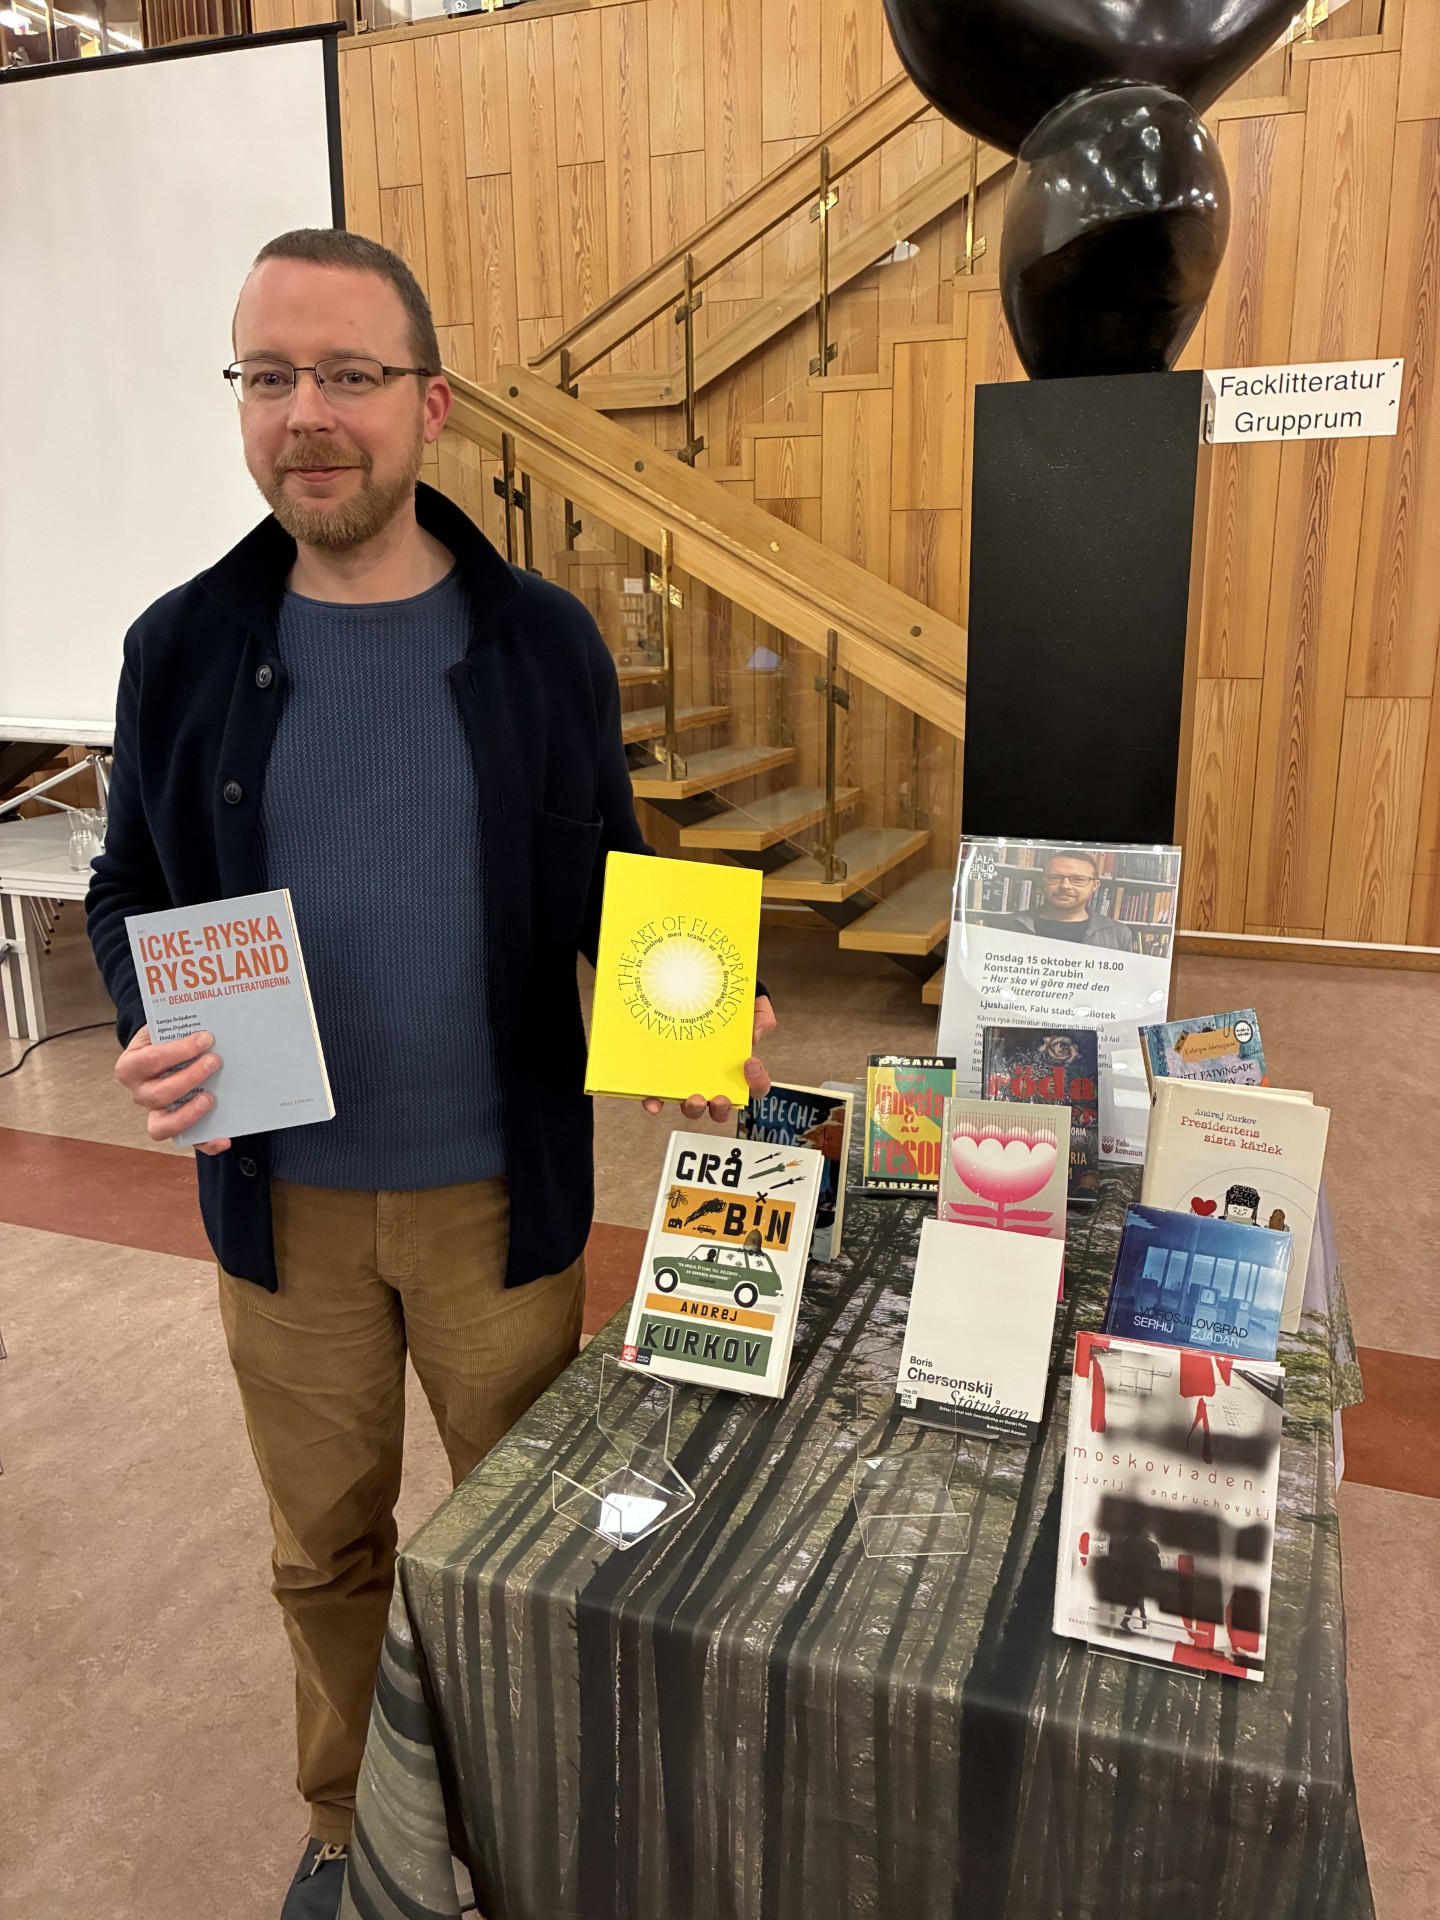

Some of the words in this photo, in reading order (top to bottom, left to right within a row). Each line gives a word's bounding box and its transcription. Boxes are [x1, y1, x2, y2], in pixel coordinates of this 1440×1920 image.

[1220, 370, 1386, 397] Facklitteratur
[1235, 410, 1362, 436] Grupprum
[631, 921, 659, 952] ART
[662, 915, 687, 932] OF
[667, 931, 682, 939] med
[139, 915, 282, 962] ICKE-RYSKA
[145, 943, 289, 995] RYSSLAND
[618, 953, 637, 990] THE
[691, 918, 749, 1027] FLERSPRÅKIGT
[984, 962, 1040, 976] Konstantin
[1043, 967, 1084, 979] Zarubin
[985, 952, 1024, 966] Onsdag
[1027, 955, 1038, 965] 15
[1040, 957, 1082, 968] oktober
[1085, 959, 1095, 969] kl
[1097, 961, 1124, 971] 18.00
[168, 987, 223, 1005] DEKOLONIALA
[224, 976, 291, 996] LITTERATURERNA
[990, 974, 1009, 984] Hur
[1010, 976, 1028, 985] ska
[1030, 978, 1040, 986] vi
[1040, 979, 1064, 989] göra
[1066, 982, 1090, 991] med
[1091, 982, 1110, 992] den
[622, 993, 715, 1041] SKRIVANDE
[980, 1000, 1028, 1013] Ljushallen,
[1030, 1005, 1049, 1014] Falu
[987, 1066, 1097, 1101] röda
[753, 1096, 819, 1128] DEPECHE
[1194, 1108, 1225, 1121] Andrej
[1226, 1113, 1257, 1126] Kurkov
[1180, 1116, 1261, 1139] Presidentens
[1115, 1147, 1143, 1157] kommun
[1116, 1139, 1130, 1148] Falu
[1203, 1133, 1237, 1147] sista
[1240, 1138, 1283, 1156] kärlek
[867, 1180, 939, 1191] ZABUZJK
[723, 1192, 792, 1245] BIN
[1133, 1315, 1174, 1333] SERHIJ
[1141, 1306, 1248, 1339] VOROSJILOVGRAD
[643, 1322, 761, 1367] KURKOV
[1190, 1328, 1241, 1349] ZJADAN
[910, 1356, 933, 1368] Boris
[907, 1367, 993, 1399] Chersonskij
[950, 1390, 1029, 1421] Stötvågen
[1150, 1488, 1271, 1521] andruchovytj
